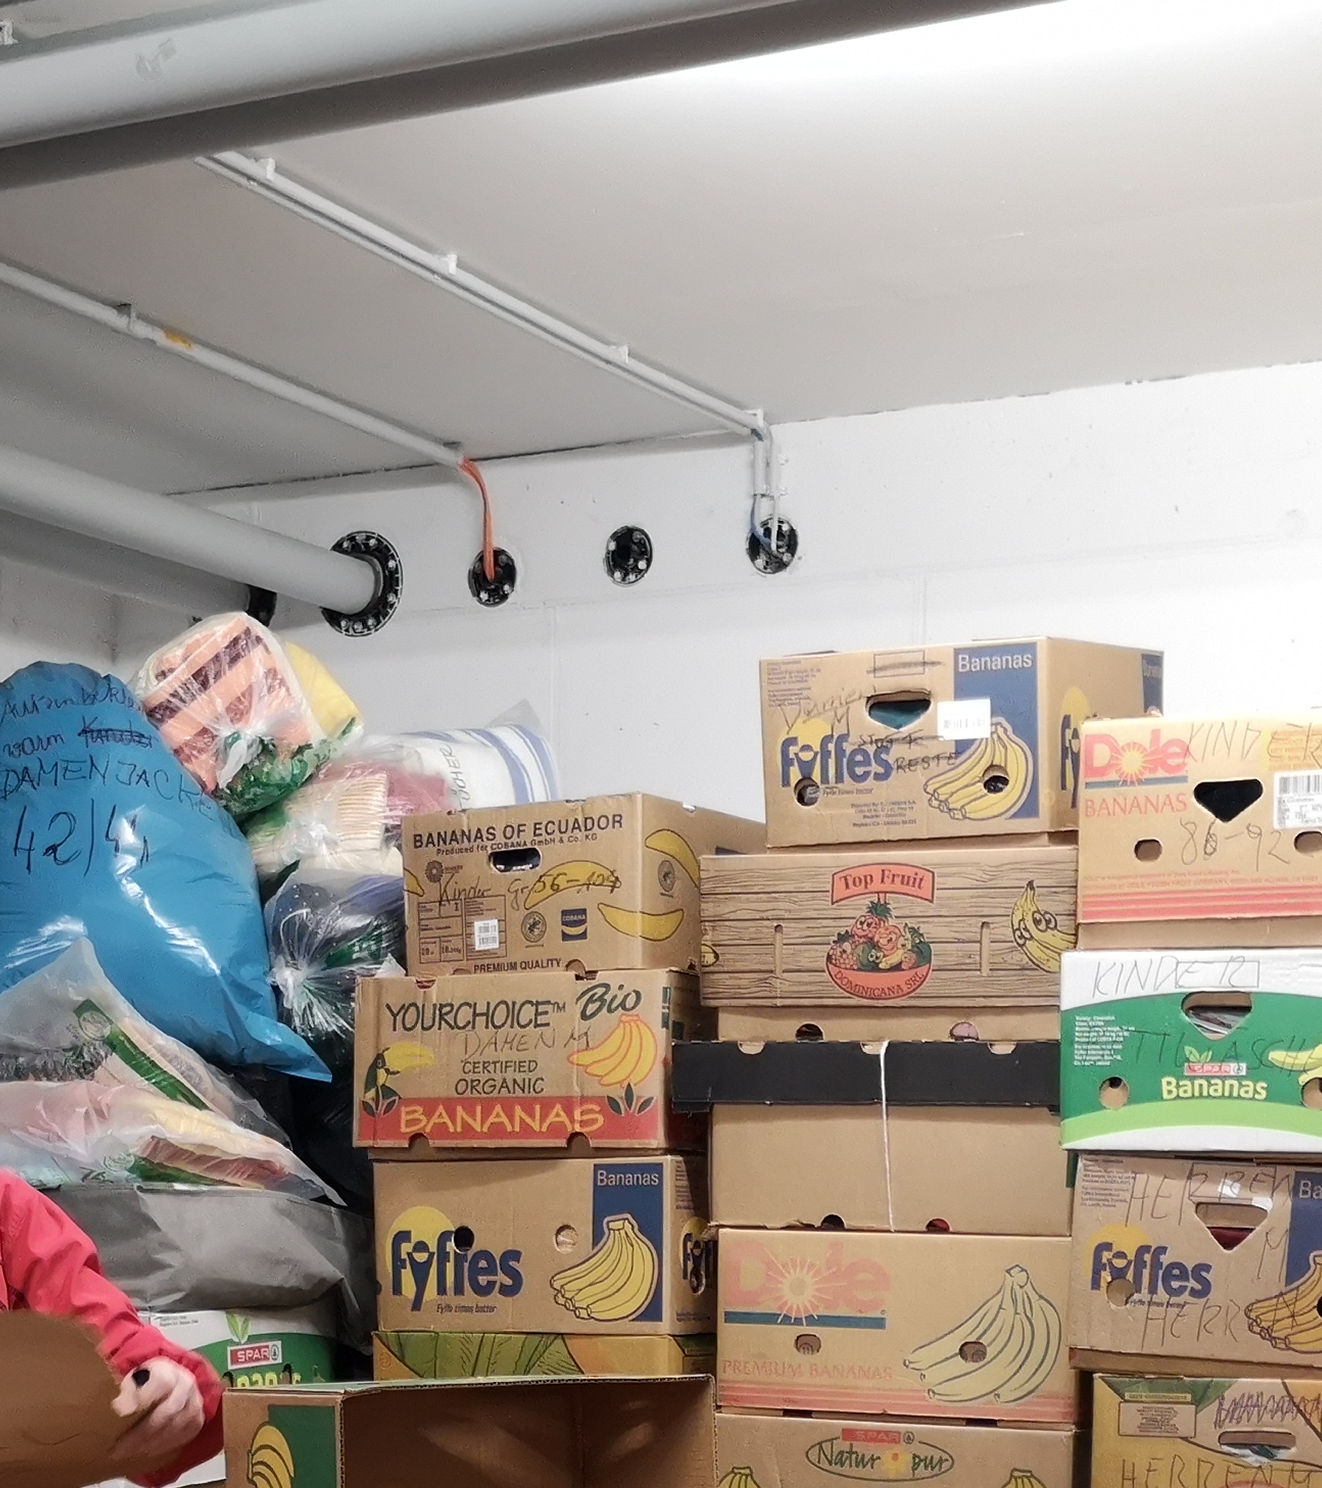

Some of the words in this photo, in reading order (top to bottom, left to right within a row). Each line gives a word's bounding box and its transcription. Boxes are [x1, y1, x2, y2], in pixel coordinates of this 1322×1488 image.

[958, 651, 1034, 673] Bananas
[780, 731, 895, 789] fyffes
[1083, 728, 1189, 784] Dole
[1083, 792, 1189, 820] BANANAS
[413, 825, 496, 849] BANANAS
[502, 823, 527, 841] OF
[533, 813, 624, 837] ECUADOR
[436, 845, 474, 857] Produced
[476, 844, 489, 853] for
[490, 840, 528, 851] COBANA
[530, 836, 556, 849] GmbH
[558, 836, 565, 844] &
[585, 833, 598, 842] KG
[839, 870, 875, 892] Top
[879, 867, 926, 890] Fruit
[473, 960, 518, 974] PREMIUM
[519, 957, 562, 972] QUALITY
[833, 970, 904, 999] DOMINICANA
[905, 971, 926, 994] SRL
[575, 982, 643, 1022] Bio
[462, 1058, 538, 1076] CERTIFIED
[455, 1077, 545, 1096] ORGANIC
[1160, 1074, 1268, 1102] Bananas
[400, 1104, 605, 1134] BANANAS
[597, 1169, 660, 1187] Bananas
[391, 1229, 524, 1312] fyffes
[724, 1240, 892, 1318] Dole
[1090, 1241, 1213, 1302] fyffes
[237, 1347, 270, 1363] SPAR
[721, 1359, 805, 1380] PREMIUM
[809, 1362, 893, 1381] BANANAS
[855, 1430, 902, 1443] SPAR
[816, 1441, 881, 1471] Natur
[911, 1454, 950, 1476] pur
